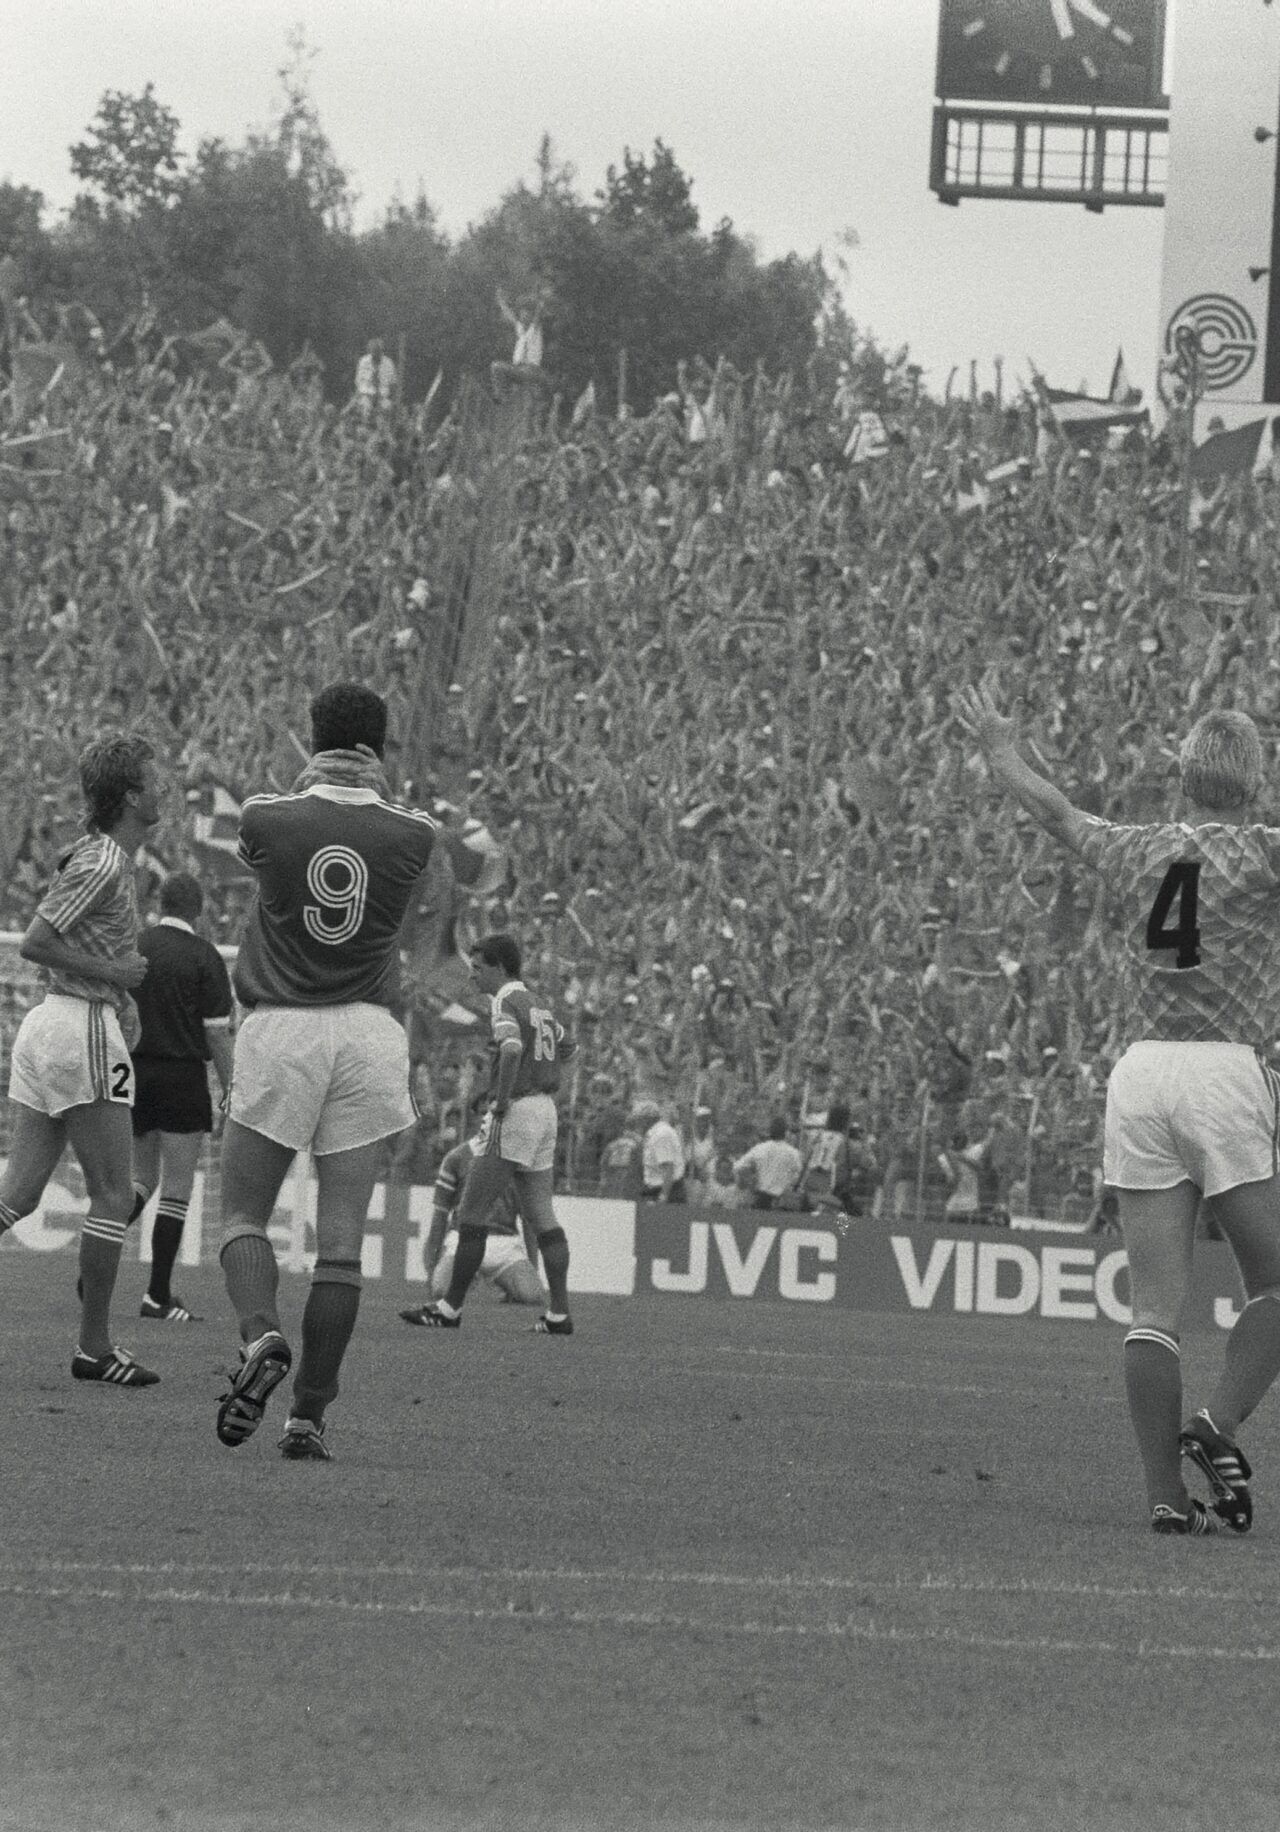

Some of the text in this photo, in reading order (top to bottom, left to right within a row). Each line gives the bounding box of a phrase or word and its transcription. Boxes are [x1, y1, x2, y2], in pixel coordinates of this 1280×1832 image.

[303, 844, 368, 945] 9
[1146, 862, 1201, 969] 4
[112, 1062, 130, 1098] 2
[651, 1221, 838, 1301] JVC
